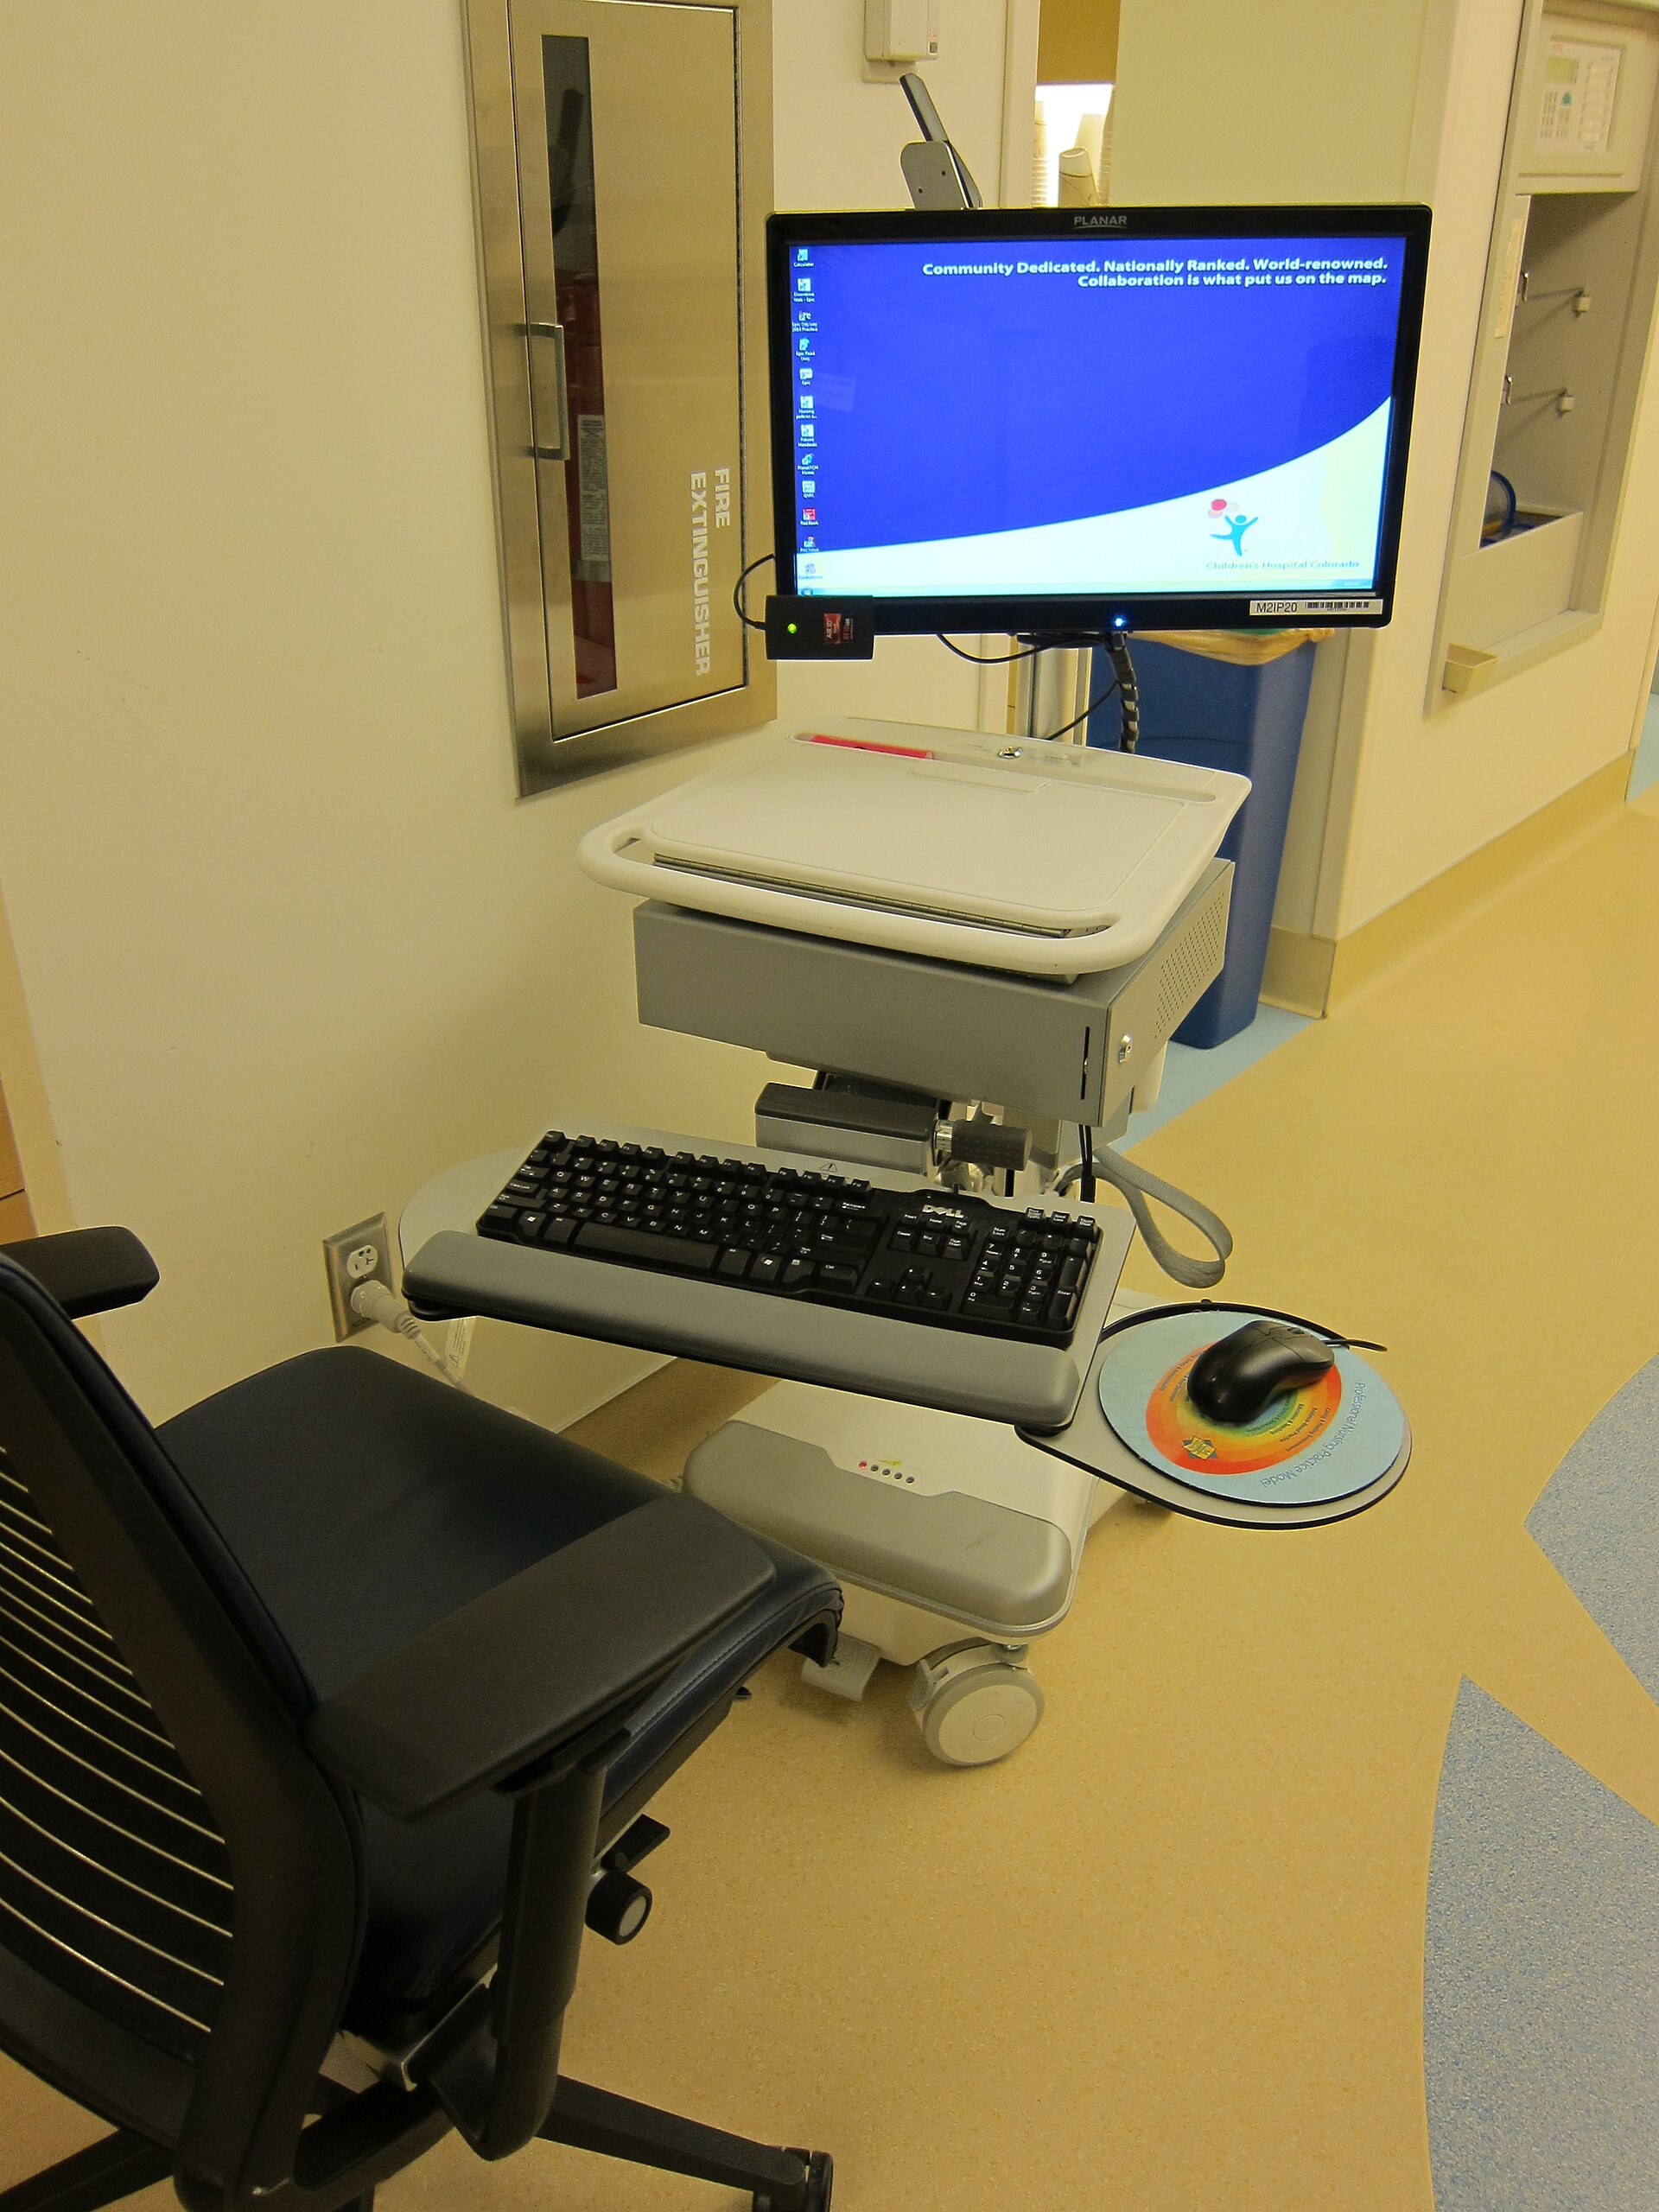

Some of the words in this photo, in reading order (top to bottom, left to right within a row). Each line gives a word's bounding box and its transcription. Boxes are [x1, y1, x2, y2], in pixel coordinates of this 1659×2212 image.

[1073, 215, 1128, 226] PLANAR
[922, 262, 1014, 276] Community
[1016, 261, 1101, 274] Dedicated.
[1103, 259, 1184, 274] Nationally
[1186, 258, 1250, 271] Ranked.
[1253, 257, 1389, 270] World-renowned.
[1077, 274, 1184, 287] Collaboration
[1187, 274, 1199, 286] is
[1203, 274, 1242, 286] what
[1244, 274, 1272, 287] put
[1274, 276, 1293, 285] us
[1295, 276, 1316, 285] on
[1319, 274, 1344, 284] the
[1348, 276, 1386, 286] map.
[714, 467, 730, 529] FIRE
[690, 471, 710, 677] EXTINGUISHER
[1262, 561, 1307, 571] Hospital
[1310, 560, 1359, 569] Colorado
[1255, 602, 1298, 613] M2IP20
[922, 1205, 964, 1218] DELL
[1345, 1382, 1366, 1427] Professional
[1323, 1424, 1355, 1451] Nursing
[1295, 1449, 1332, 1474] Practice
[1260, 1469, 1298, 1488] Model
